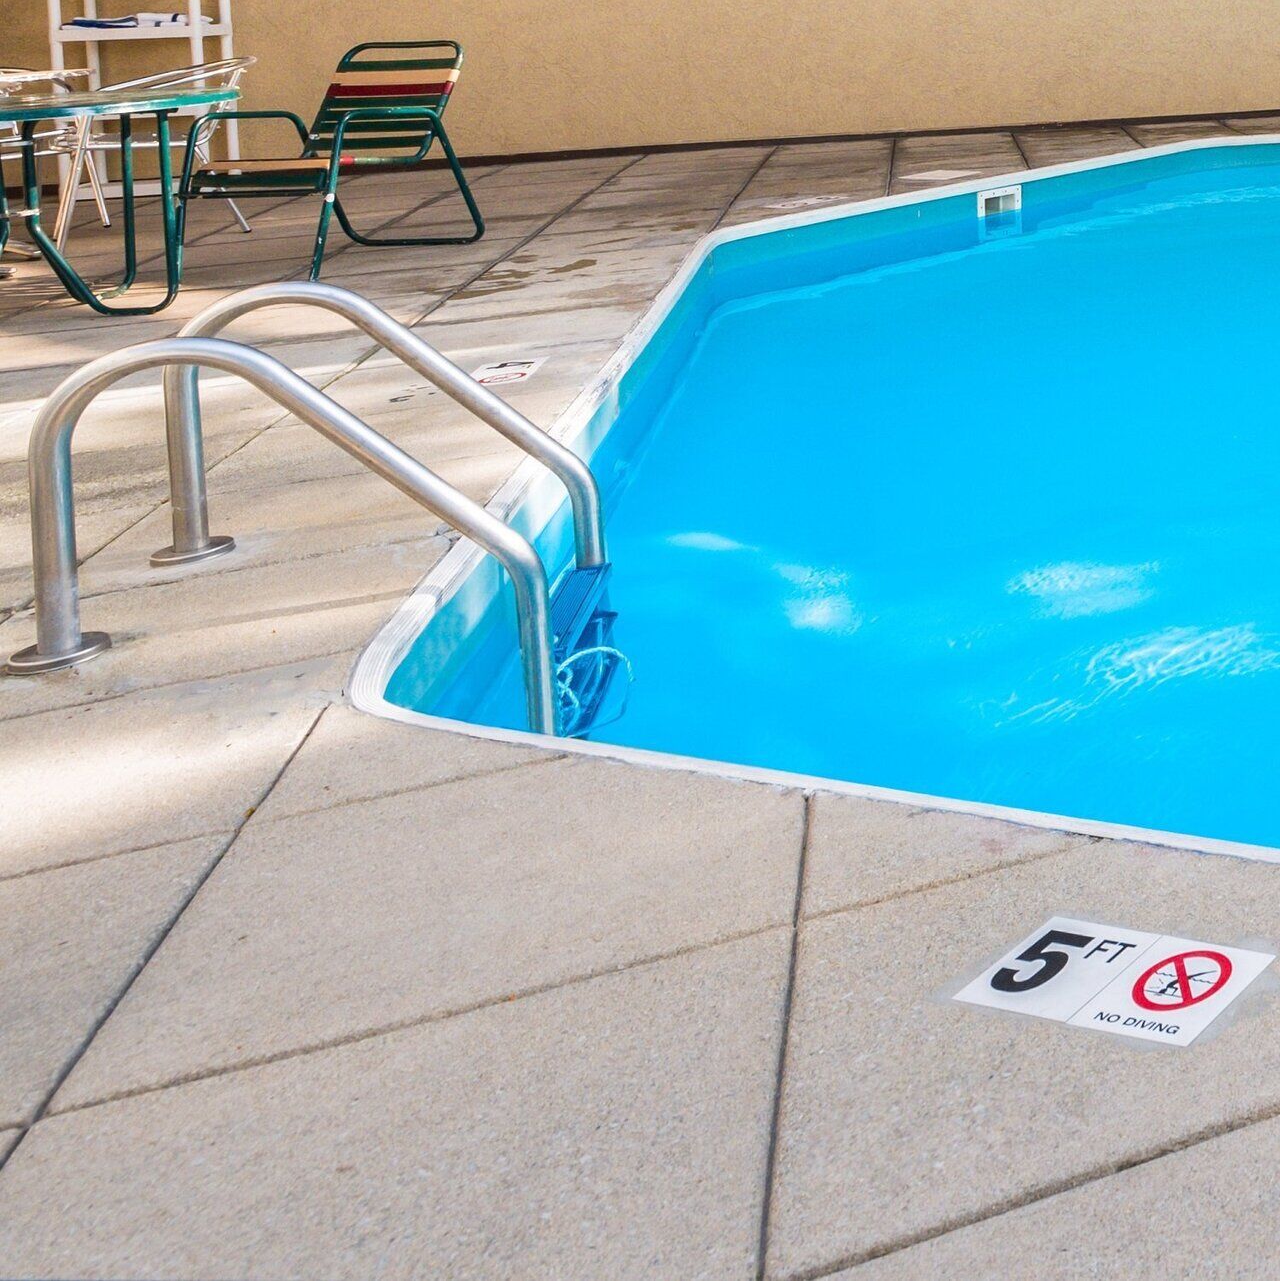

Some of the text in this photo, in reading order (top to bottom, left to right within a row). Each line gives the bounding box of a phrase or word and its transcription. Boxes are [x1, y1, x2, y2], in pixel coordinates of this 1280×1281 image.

[990, 930, 1136, 992] 5 FT
[1094, 1011, 1180, 1035] NO DIVING
